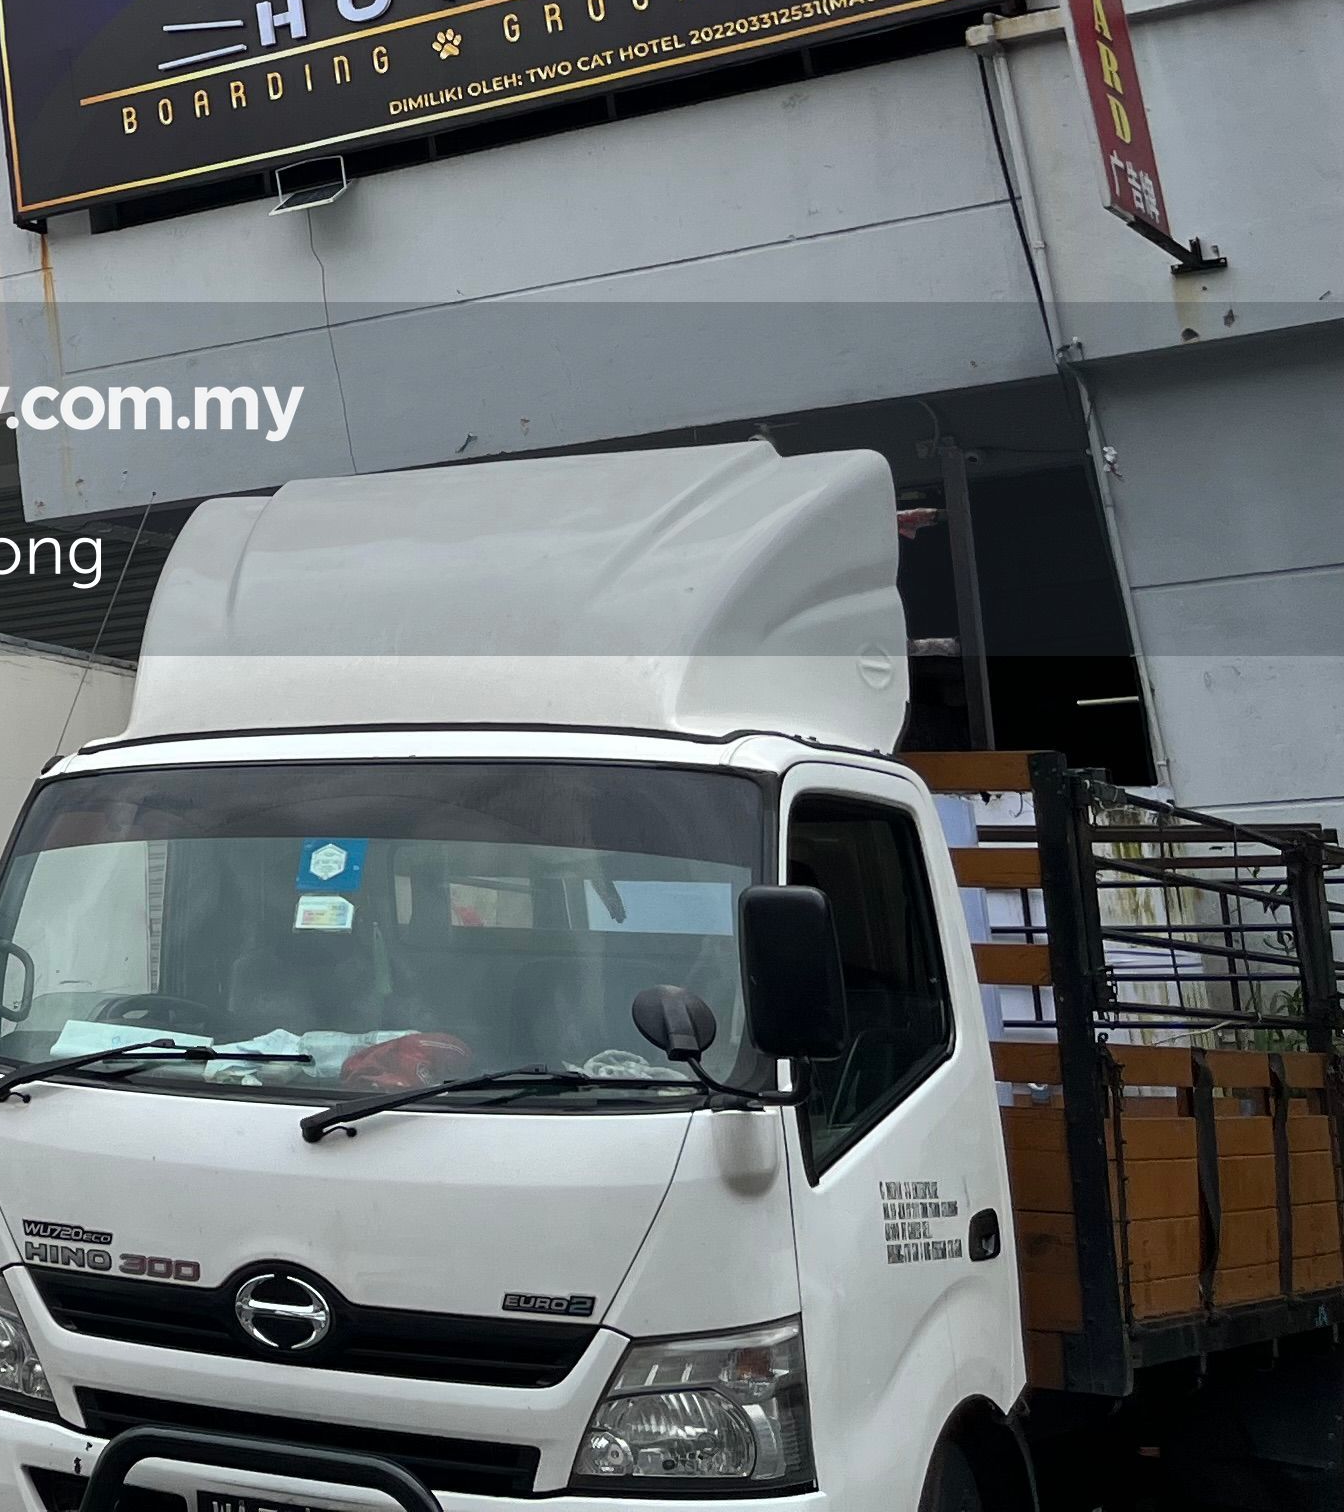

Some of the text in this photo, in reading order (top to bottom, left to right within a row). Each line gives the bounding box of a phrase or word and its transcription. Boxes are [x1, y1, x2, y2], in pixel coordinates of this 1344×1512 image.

[122, 45, 389, 134] BOARDING
[389, 86, 463, 115] DIMILIKI
[467, 72, 524, 97] OLEH:
[526, 59, 572, 85] TWO
[577, 49, 616, 72] CAT
[619, 33, 686, 63] HOTEL
[25, 1241, 200, 1282] HINO 300
